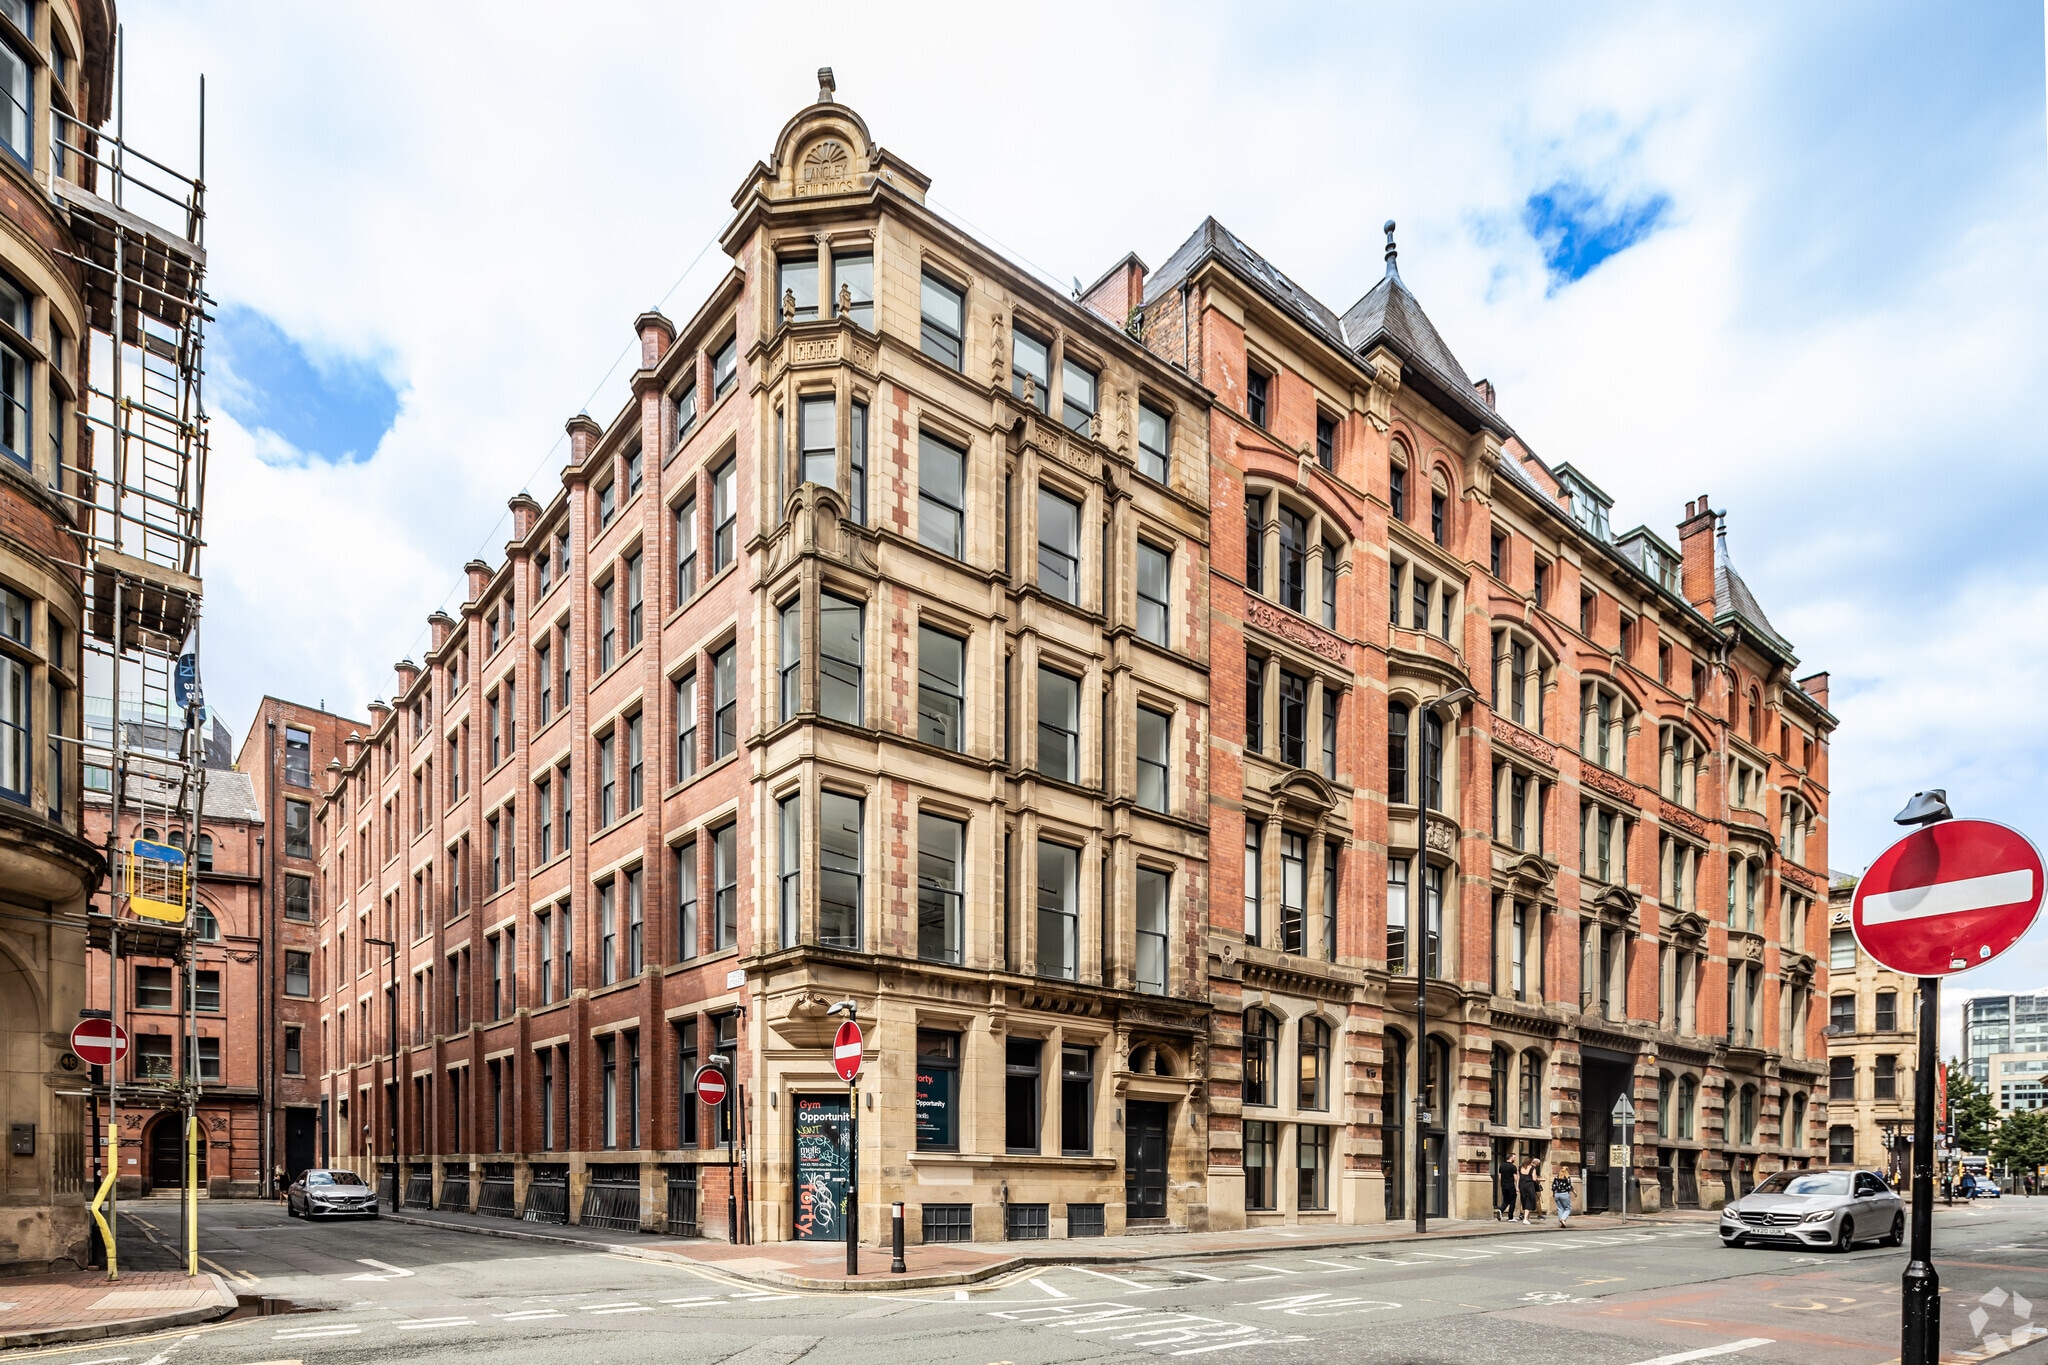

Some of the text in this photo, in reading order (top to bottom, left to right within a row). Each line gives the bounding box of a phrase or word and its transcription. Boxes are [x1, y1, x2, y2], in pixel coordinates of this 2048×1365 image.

[804, 164, 848, 183] LANGLEY
[800, 1100, 821, 1112] Gym
[916, 1100, 946, 1109] Opportunity
[800, 1112, 850, 1124] Opportunit
[800, 1146, 821, 1154] metis
[795, 1183, 817, 1237] forty.
